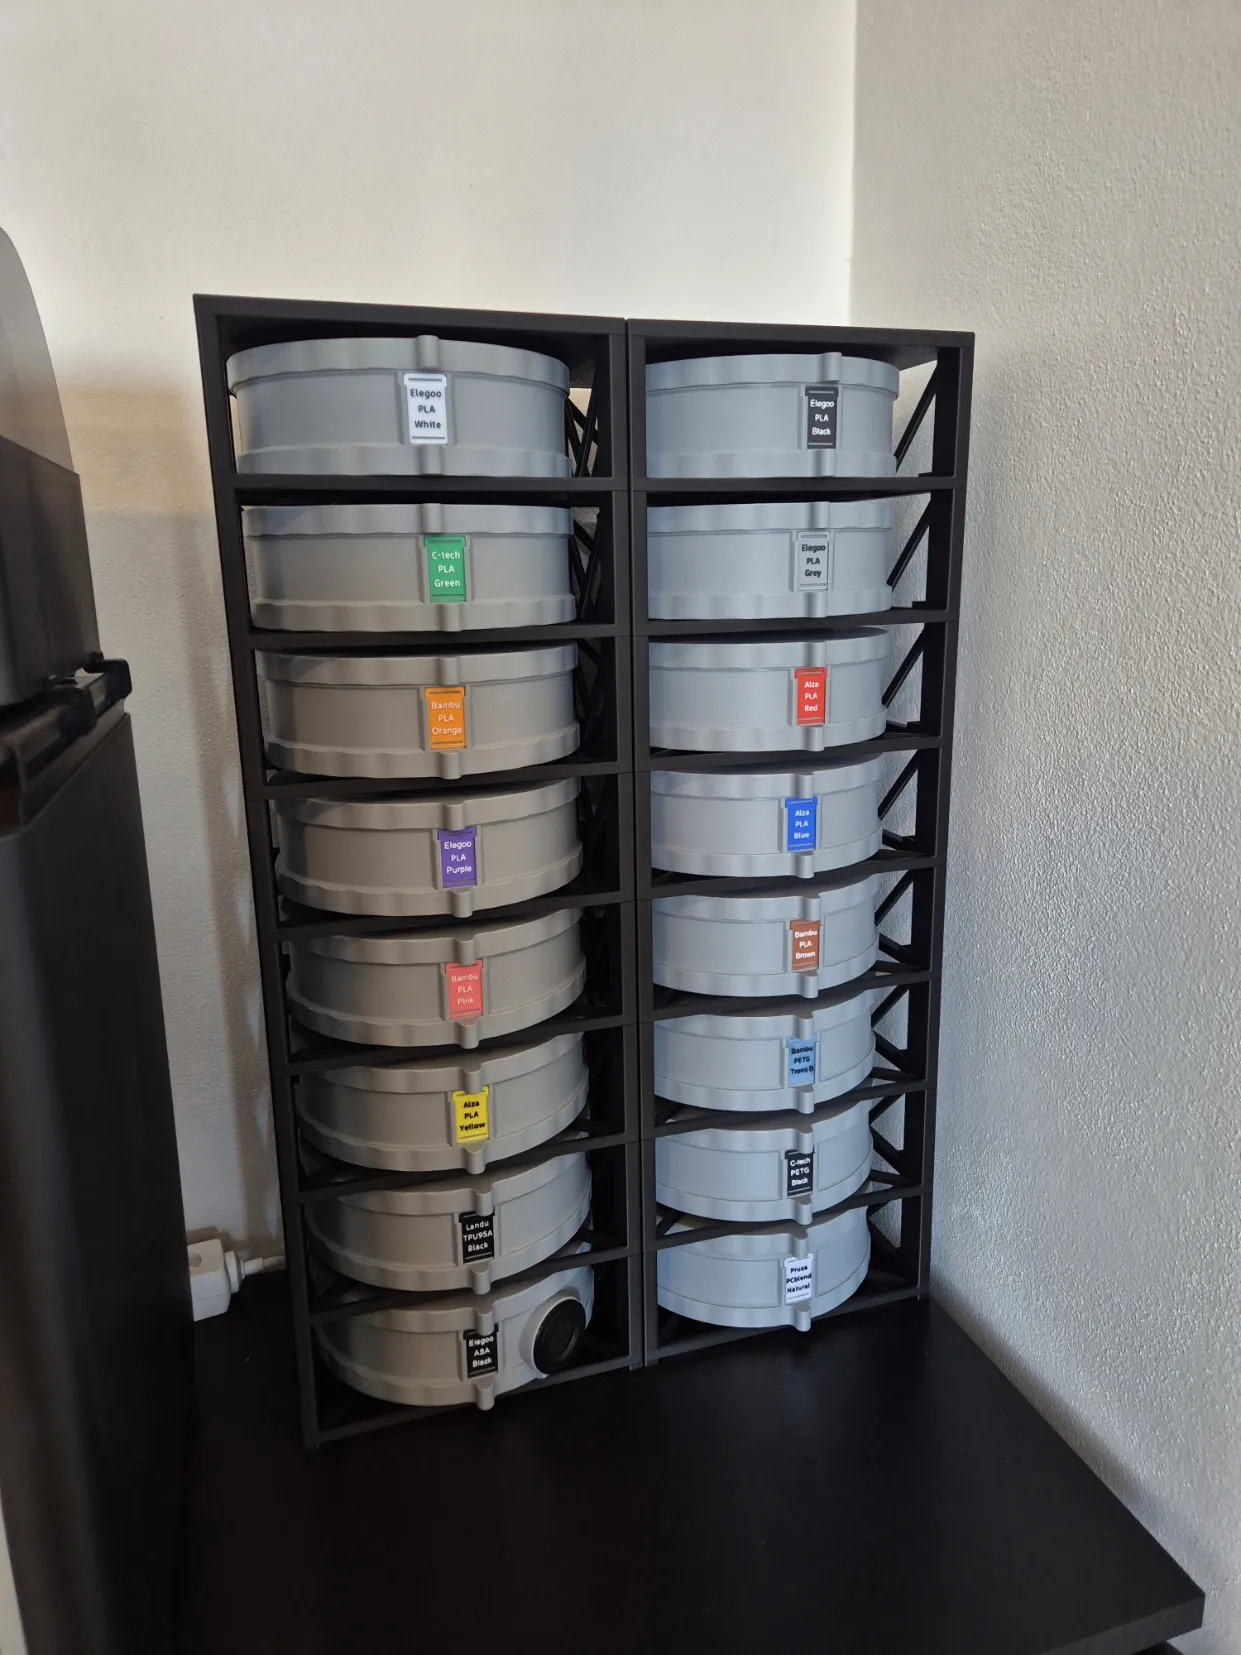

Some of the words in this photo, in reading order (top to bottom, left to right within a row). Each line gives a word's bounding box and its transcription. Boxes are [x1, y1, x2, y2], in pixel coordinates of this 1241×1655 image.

[410, 389, 442, 399] Elegoo
[810, 399, 834, 410] Elegoo
[415, 421, 441, 429] White
[812, 426, 831, 435] Black
[802, 544, 826, 554] Elegoo
[805, 569, 821, 578] Grey
[435, 579, 460, 587] Green
[432, 701, 460, 709] Bambu
[432, 726, 462, 735] Orange
[444, 840, 472, 850] Elegoo
[446, 865, 472, 874] Purple
[794, 930, 817, 938] Bambu
[796, 951, 816, 960] Brown
[451, 973, 478, 983] Bambu
[457, 996, 474, 1005] Pink
[791, 1046, 813, 1055] Bambu
[460, 1122, 486, 1132] Yellow
[791, 1167, 809, 1176] PETG
[792, 1178, 808, 1186] Black
[466, 1221, 489, 1230] Landu
[463, 1231, 493, 1242] TPU95A
[468, 1242, 488, 1252] Black
[790, 1265, 808, 1274] Prusa
[786, 1273, 812, 1284] PCblend
[787, 1284, 810, 1294] Natural
[472, 1357, 492, 1368] Black
